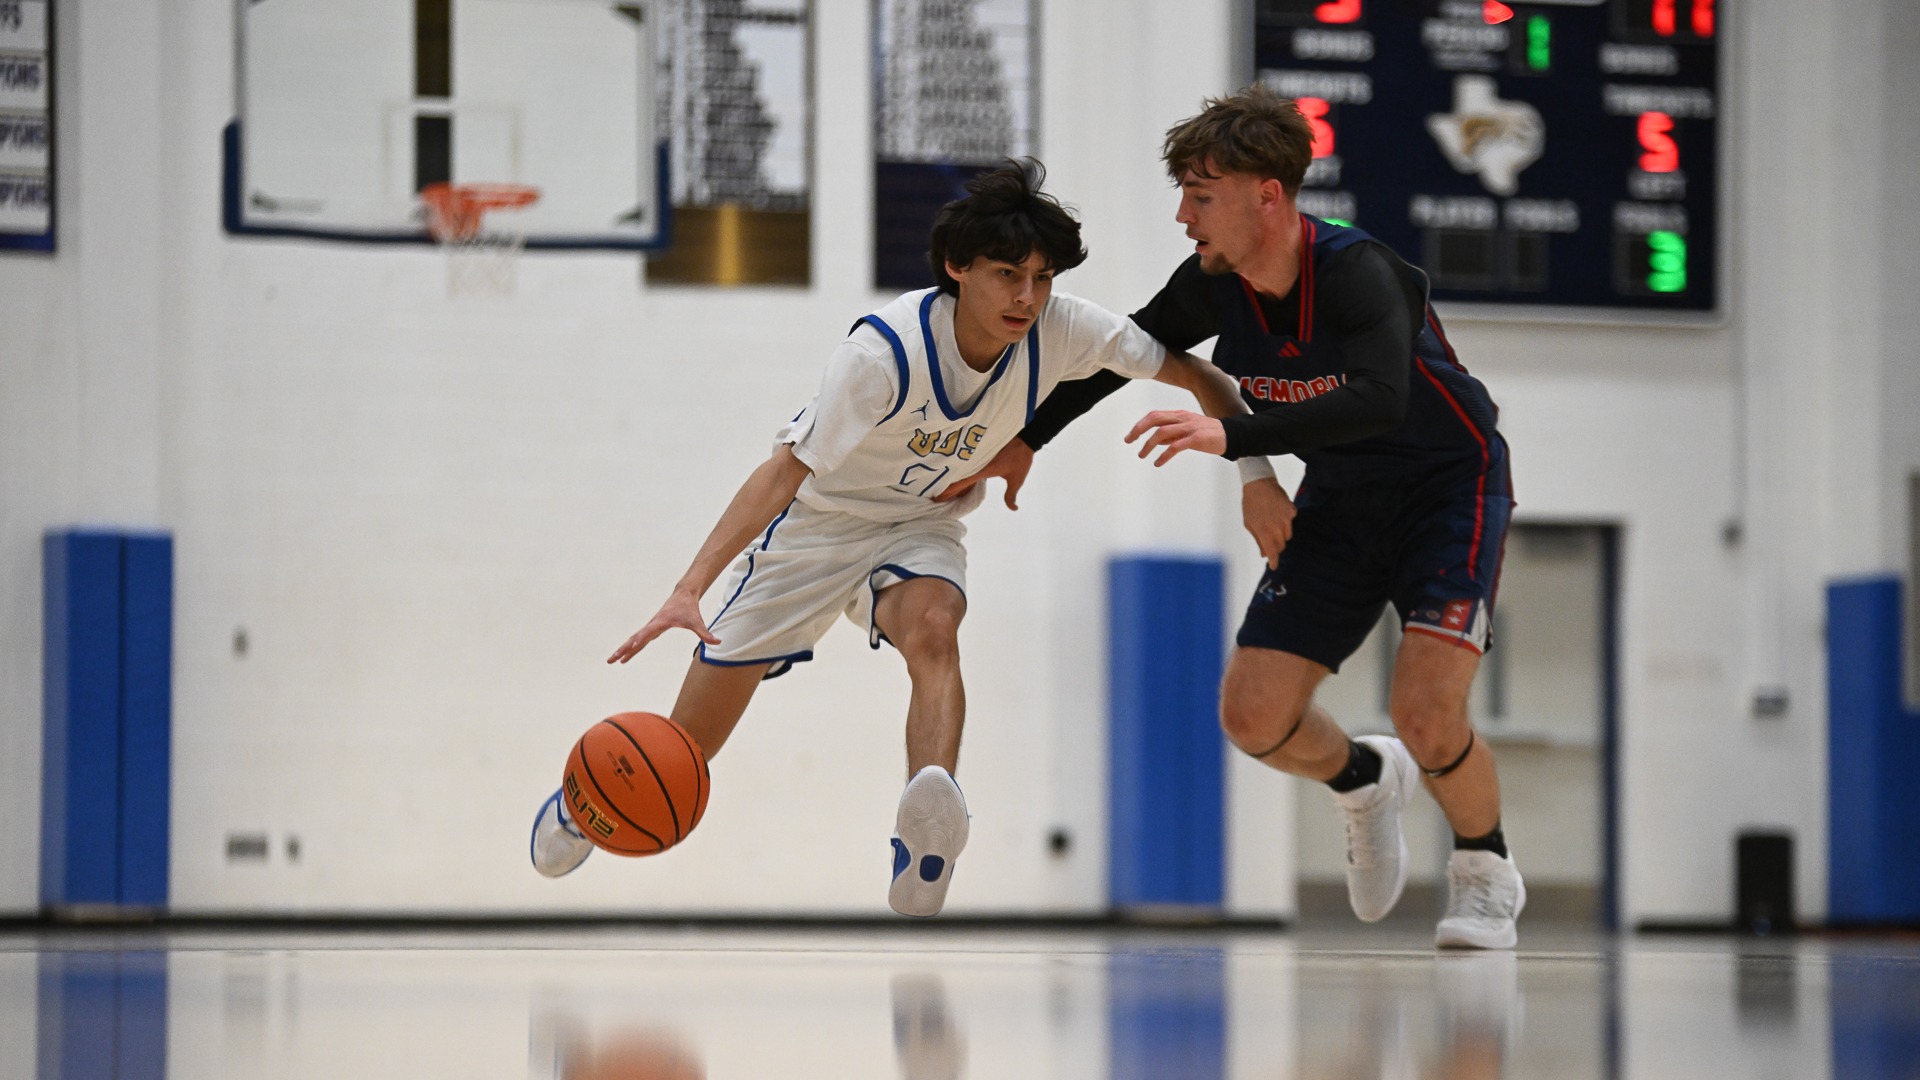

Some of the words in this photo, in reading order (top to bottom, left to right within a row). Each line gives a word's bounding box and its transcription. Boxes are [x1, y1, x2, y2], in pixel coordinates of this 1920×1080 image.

[1637, 111, 1680, 173] 5
[1646, 230, 1687, 292] 3
[566, 771, 615, 839] ELITE
